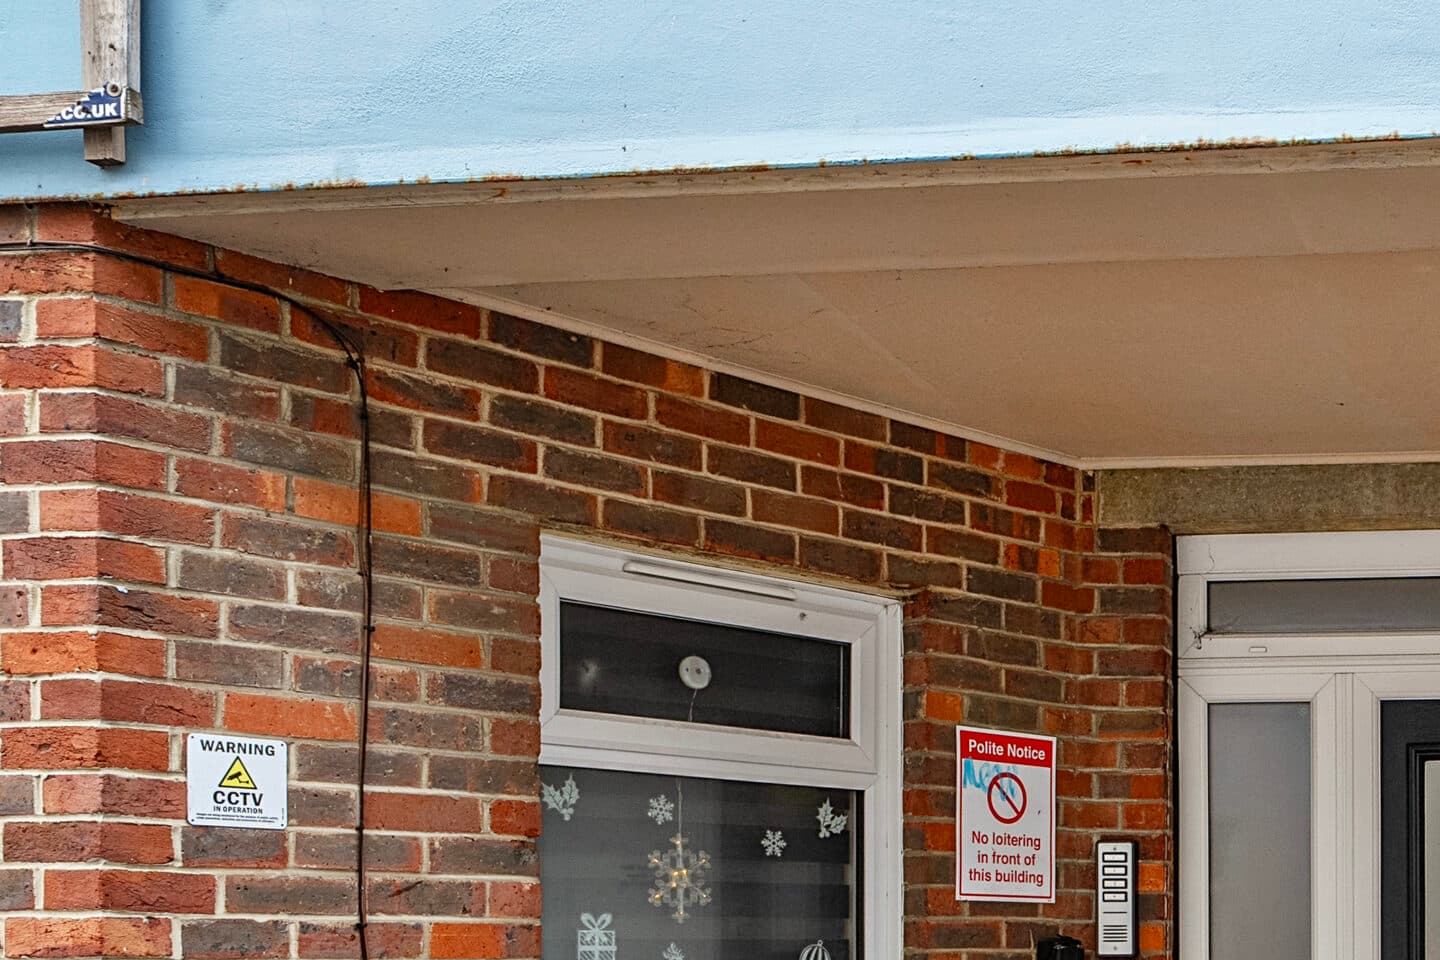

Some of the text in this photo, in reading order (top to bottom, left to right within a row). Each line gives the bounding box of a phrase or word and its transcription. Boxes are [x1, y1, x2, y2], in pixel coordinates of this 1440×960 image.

[47, 102, 118, 121] .CO.UK
[200, 739, 276, 757] WARNING
[968, 738, 1046, 760] Polite Notice
[213, 790, 263, 807] CCTV
[222, 806, 263, 815] OPERATION
[971, 830, 1041, 851] No loitering
[977, 850, 1036, 866] in front of
[968, 868, 1044, 887] this building
